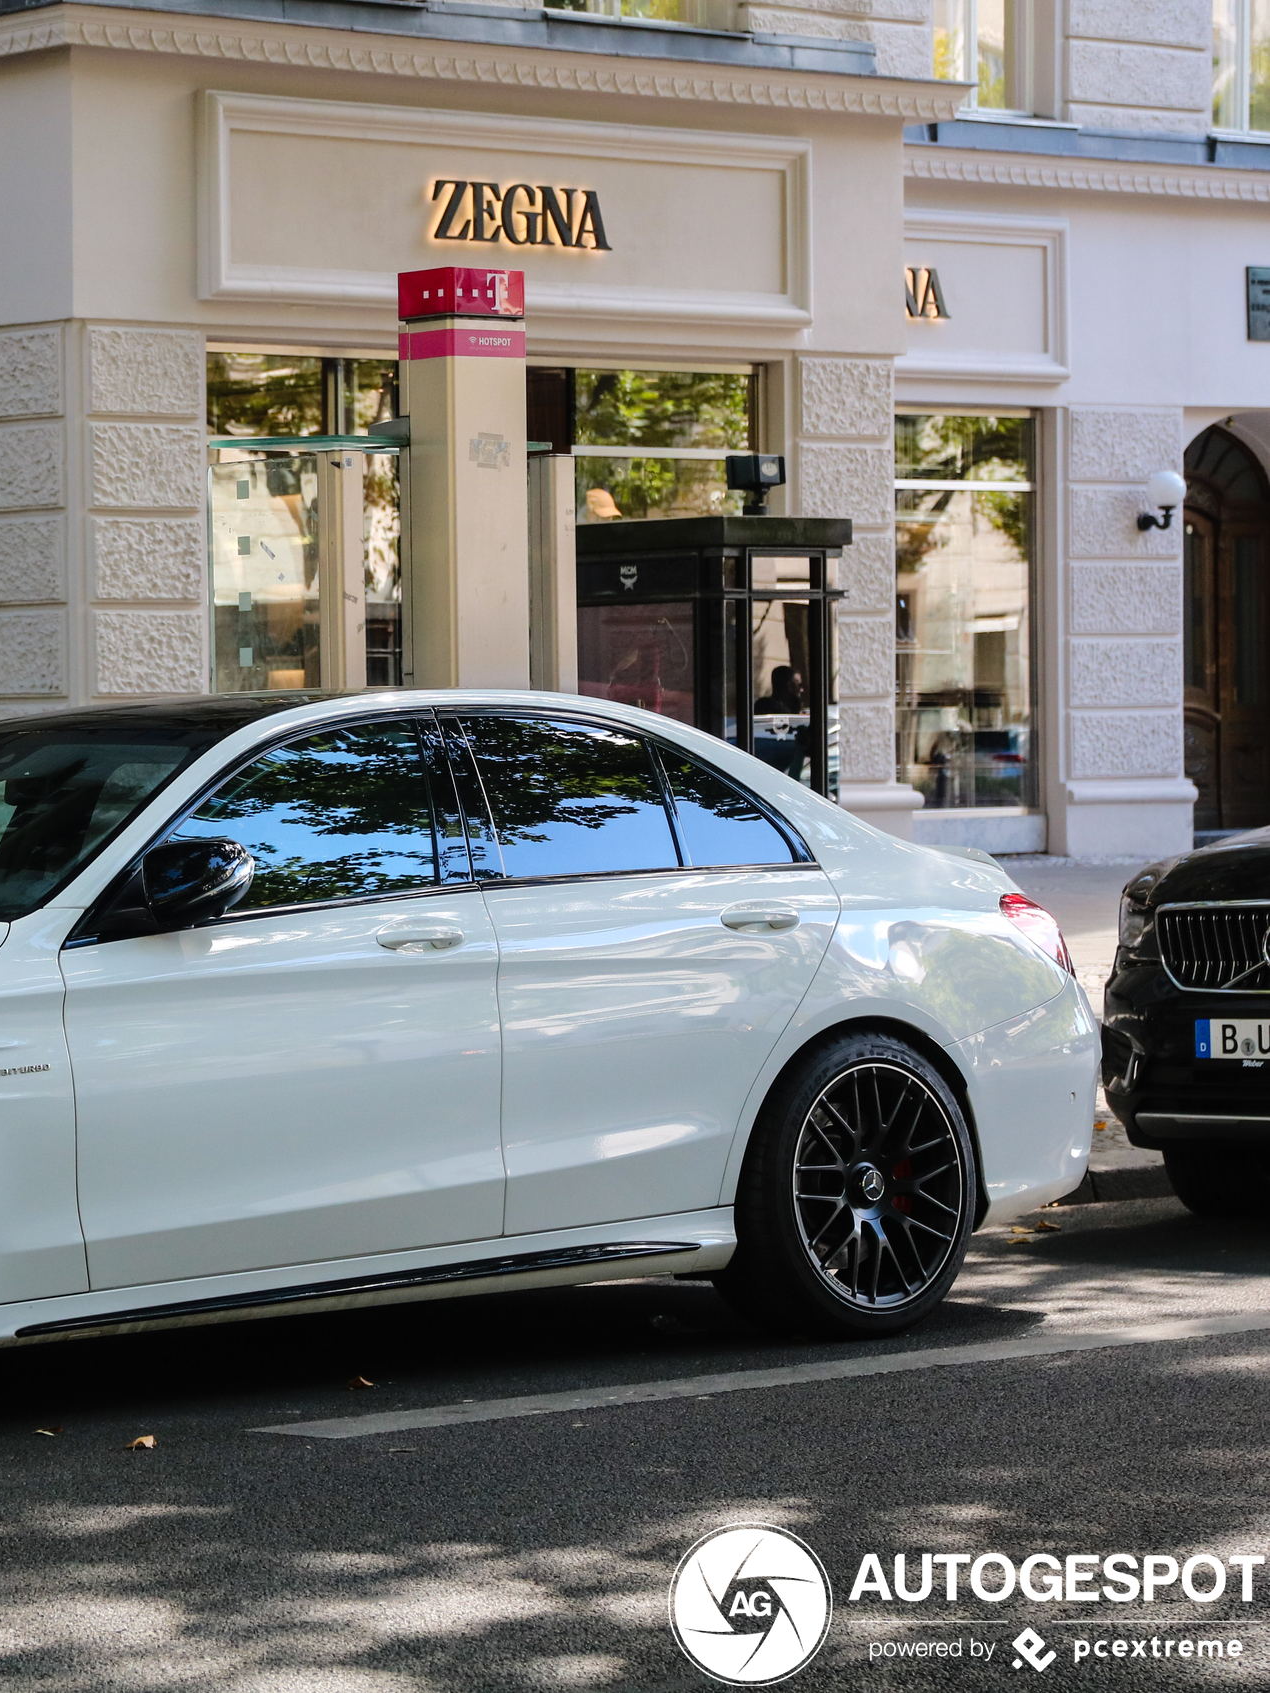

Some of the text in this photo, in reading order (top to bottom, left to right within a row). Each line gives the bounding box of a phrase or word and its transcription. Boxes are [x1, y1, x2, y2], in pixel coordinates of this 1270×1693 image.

[431, 179, 613, 251] ZEGNA
[486, 272, 509, 311] T
[478, 336, 512, 346] HOTSPOT
[620, 565, 637, 575] MCM
[1222, 1024, 1238, 1055] B
[0, 1063, 51, 1077] BITURBO
